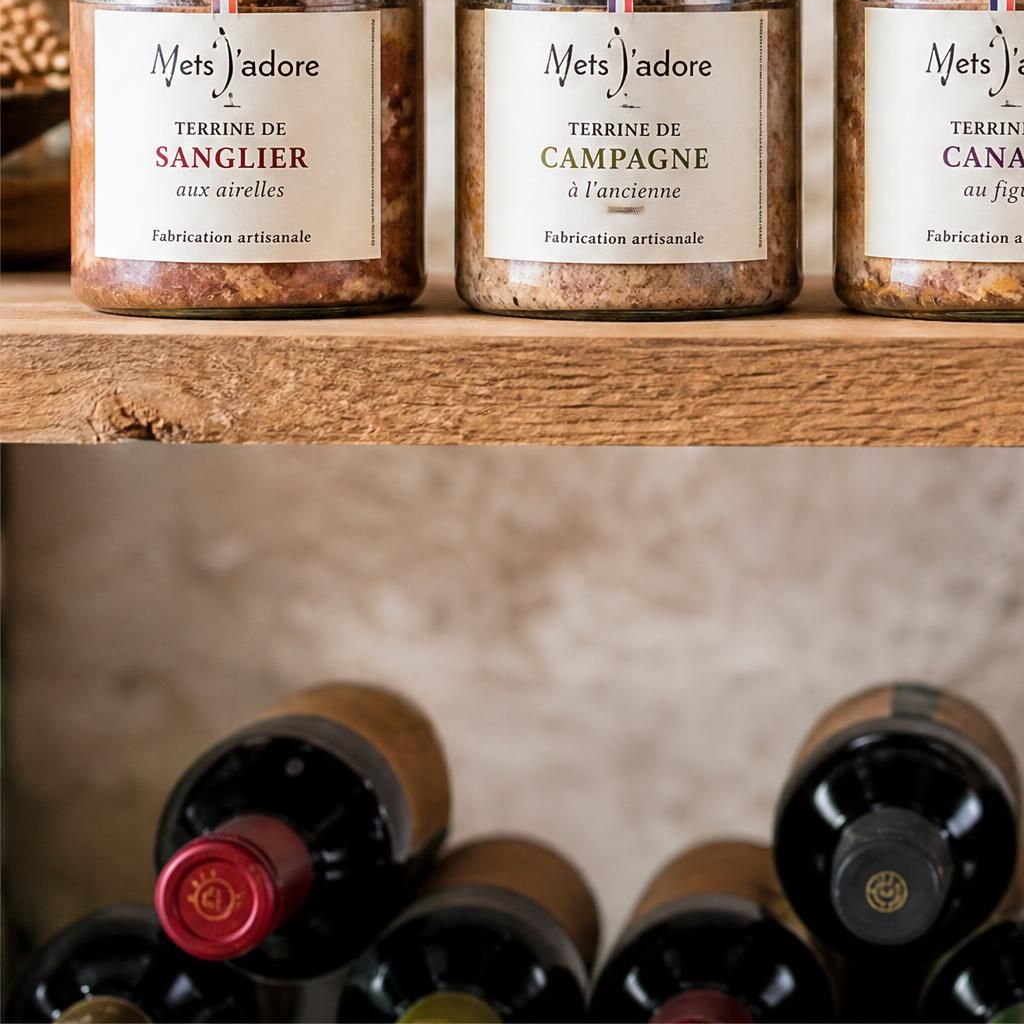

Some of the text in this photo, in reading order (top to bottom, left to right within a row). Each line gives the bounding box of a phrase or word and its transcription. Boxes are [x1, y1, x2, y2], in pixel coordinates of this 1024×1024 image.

[149, 42, 215, 88] Mets
[543, 42, 610, 88] Mets
[924, 41, 991, 87] Mets
[174, 120, 287, 137] TERRINE DE
[567, 121, 682, 137] TERRINE DE
[155, 145, 309, 169] SANGLIER
[540, 145, 710, 170] CAMPAGNE
[175, 180, 285, 199] aux airelles
[567, 180, 682, 200] à l'ancienne
[963, 184, 987, 198] au
[151, 229, 312, 244] Fabrication artisanale
[544, 230, 705, 246] Fabrication artisanale
[925, 229, 1009, 245] Fabrication
